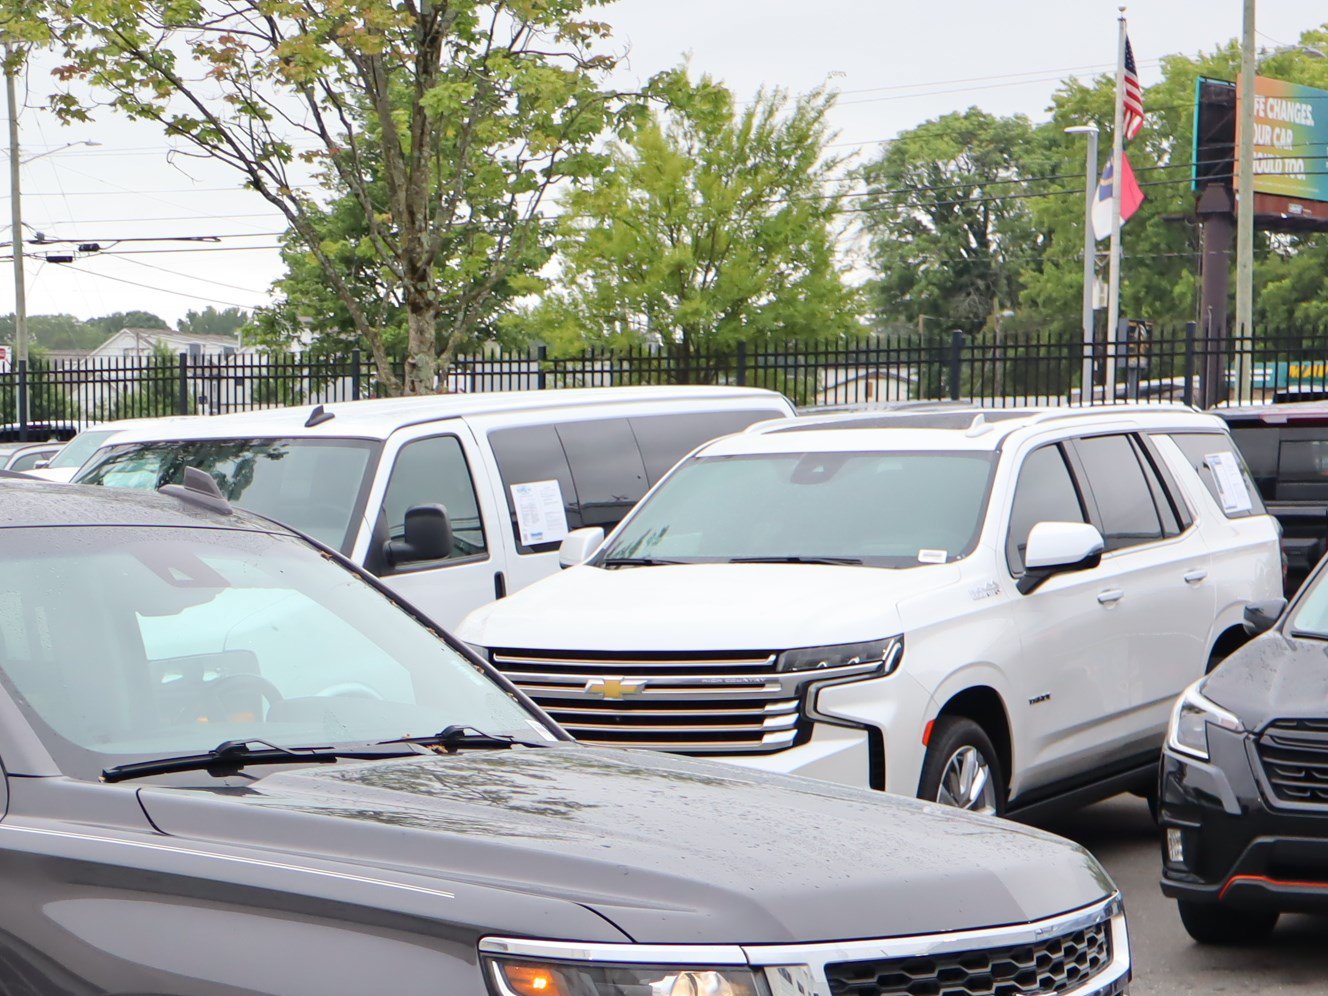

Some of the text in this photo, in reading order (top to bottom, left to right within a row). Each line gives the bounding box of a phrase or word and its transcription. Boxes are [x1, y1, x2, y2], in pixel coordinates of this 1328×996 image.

[1266, 97, 1315, 127] CHANGES.
[1273, 127, 1293, 150] CAR
[1284, 157, 1306, 181] TOO.
